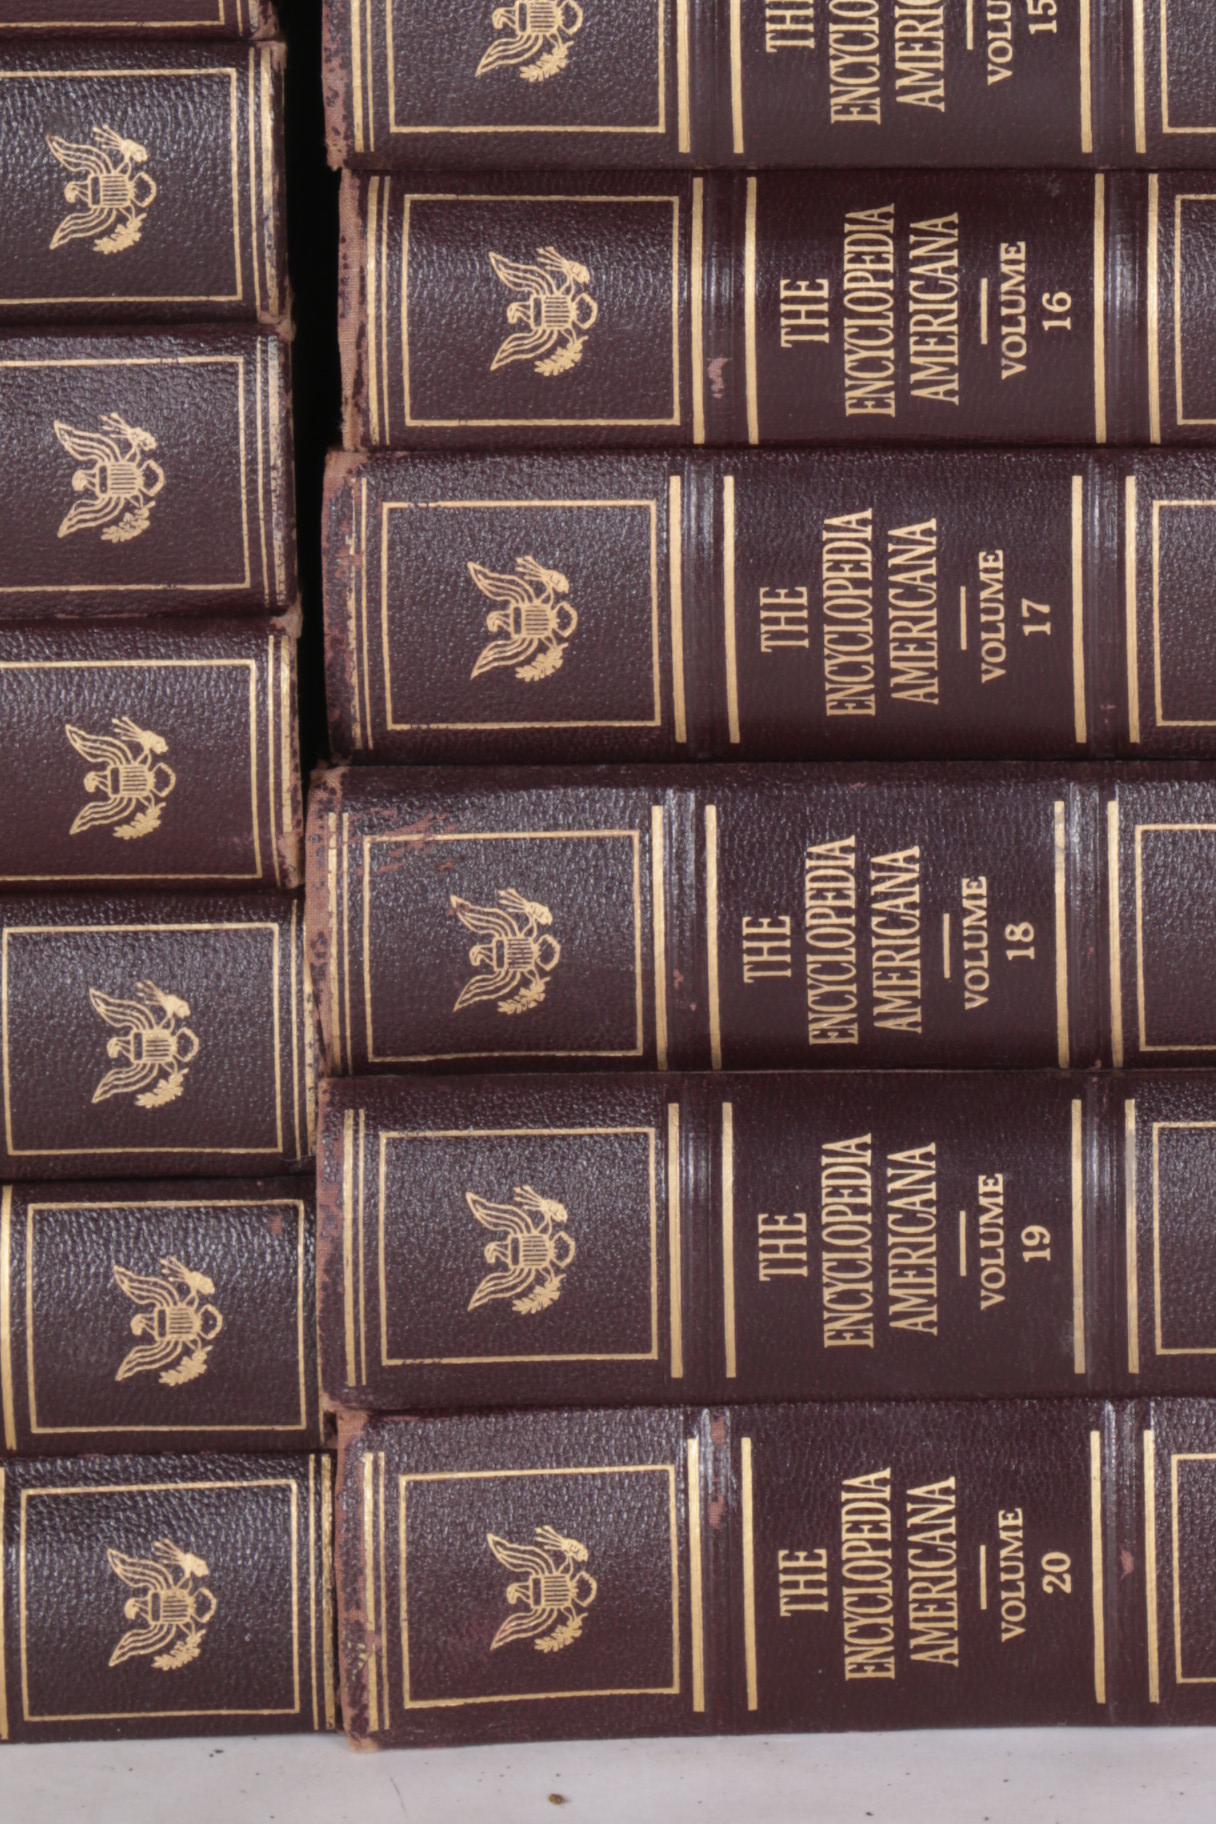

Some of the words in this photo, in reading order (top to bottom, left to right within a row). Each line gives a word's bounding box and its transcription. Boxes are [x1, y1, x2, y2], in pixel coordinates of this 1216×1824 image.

[779, 278, 831, 348] THE
[843, 203, 896, 416] ENCYCLOPEDIA
[909, 212, 960, 406] AMERICANA
[1000, 241, 1028, 381] VOLUME
[1041, 290, 1073, 330] 16
[759, 587, 809, 653] THE
[821, 508, 876, 717] ENCYCLOPEDIA
[886, 518, 939, 705] AMERICANA
[978, 549, 1007, 683] VOLUME
[1021, 598, 1052, 637] 17
[742, 915, 793, 984] THE
[805, 835, 859, 1045] ENCYCLOPEDIA
[870, 846, 923, 1034] AMERICANA
[961, 876, 990, 1011] VOLUME
[1005, 921, 1036, 961] 18
[757, 1212, 808, 1282] THE
[821, 1133, 874, 1348] ENCYCLOPEDIA
[887, 1142, 939, 1337] AMERICANA
[977, 1174, 1007, 1311] VOLUME
[1022, 1224, 1052, 1263] 19
[778, 1548, 830, 1616] THE
[840, 1468, 896, 1681] ENCYCLOPEDIA
[905, 1476, 960, 1668] AMERICANA
[997, 1508, 1027, 1643] VOLUME
[1041, 1551, 1073, 1595] 20
